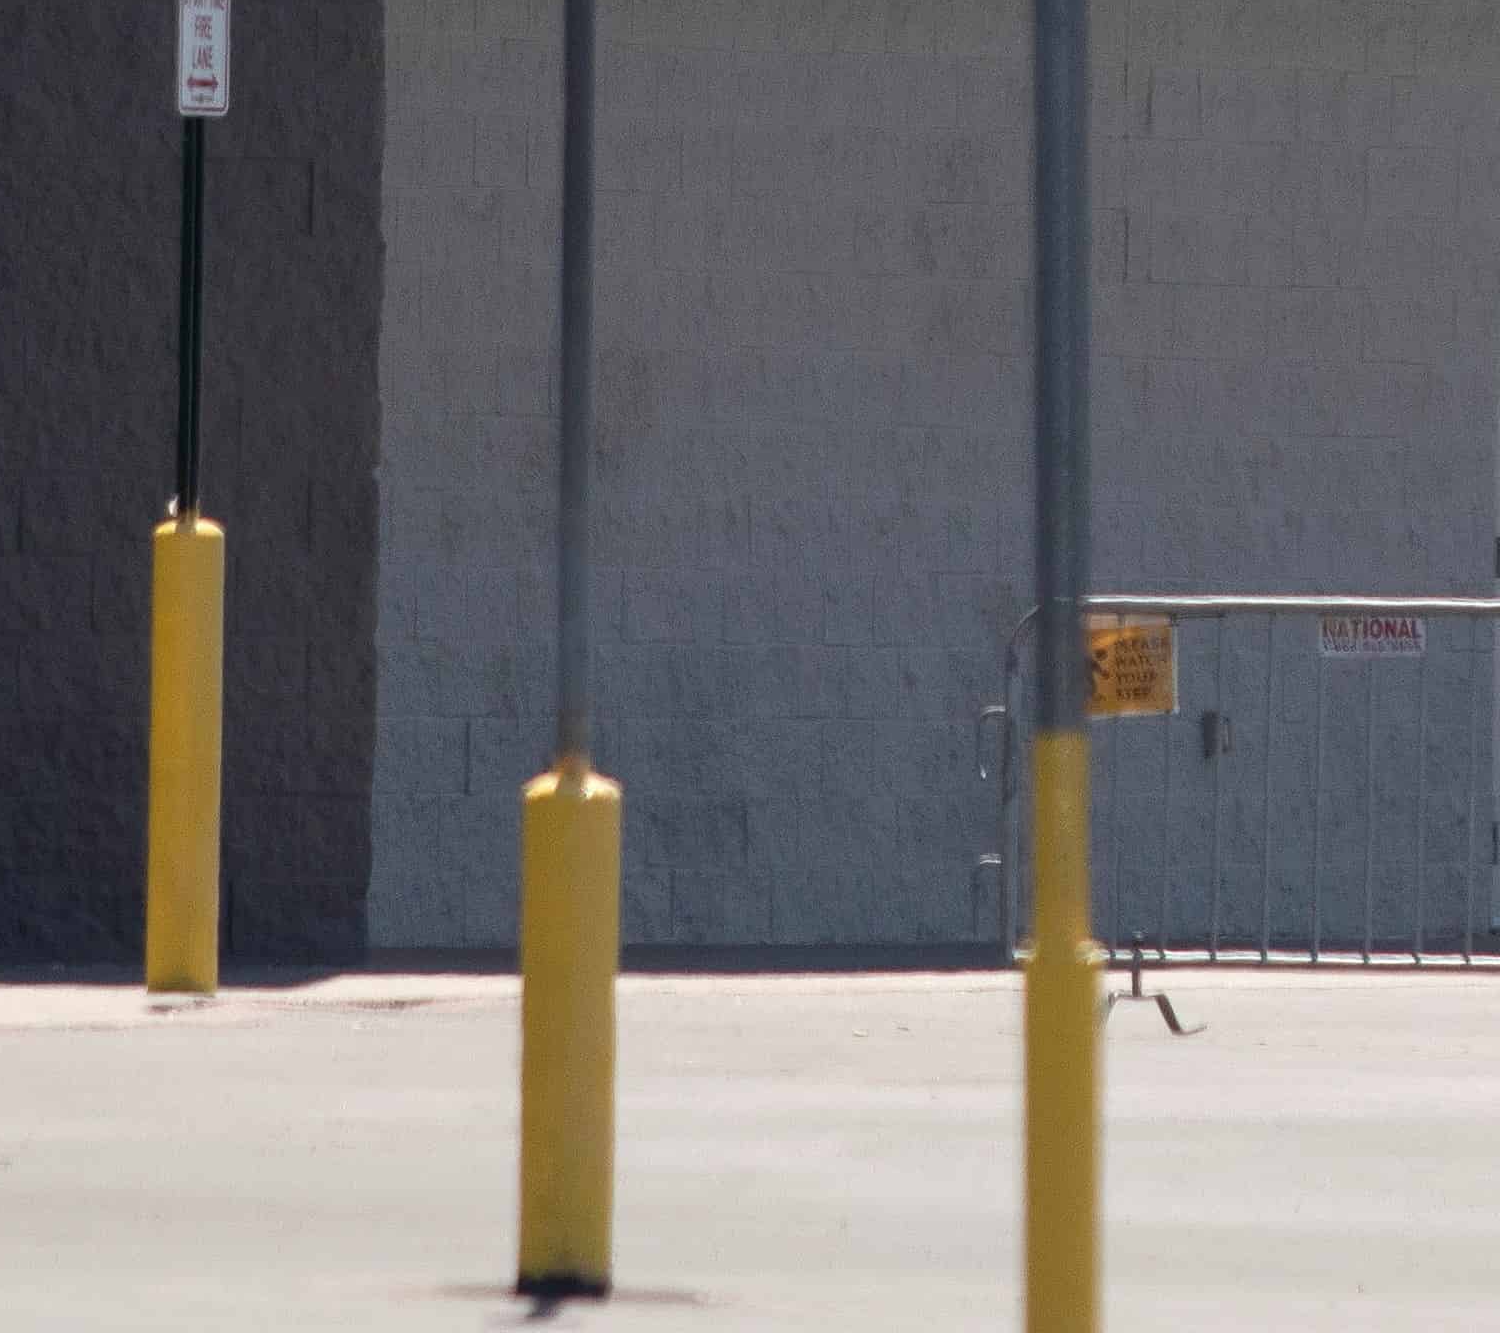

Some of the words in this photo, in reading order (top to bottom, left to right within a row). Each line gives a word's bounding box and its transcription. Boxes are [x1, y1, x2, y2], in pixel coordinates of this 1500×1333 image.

[195, 15, 213, 40] FIRE
[192, 45, 213, 70] LANE
[1322, 618, 1422, 639] NATIONAL
